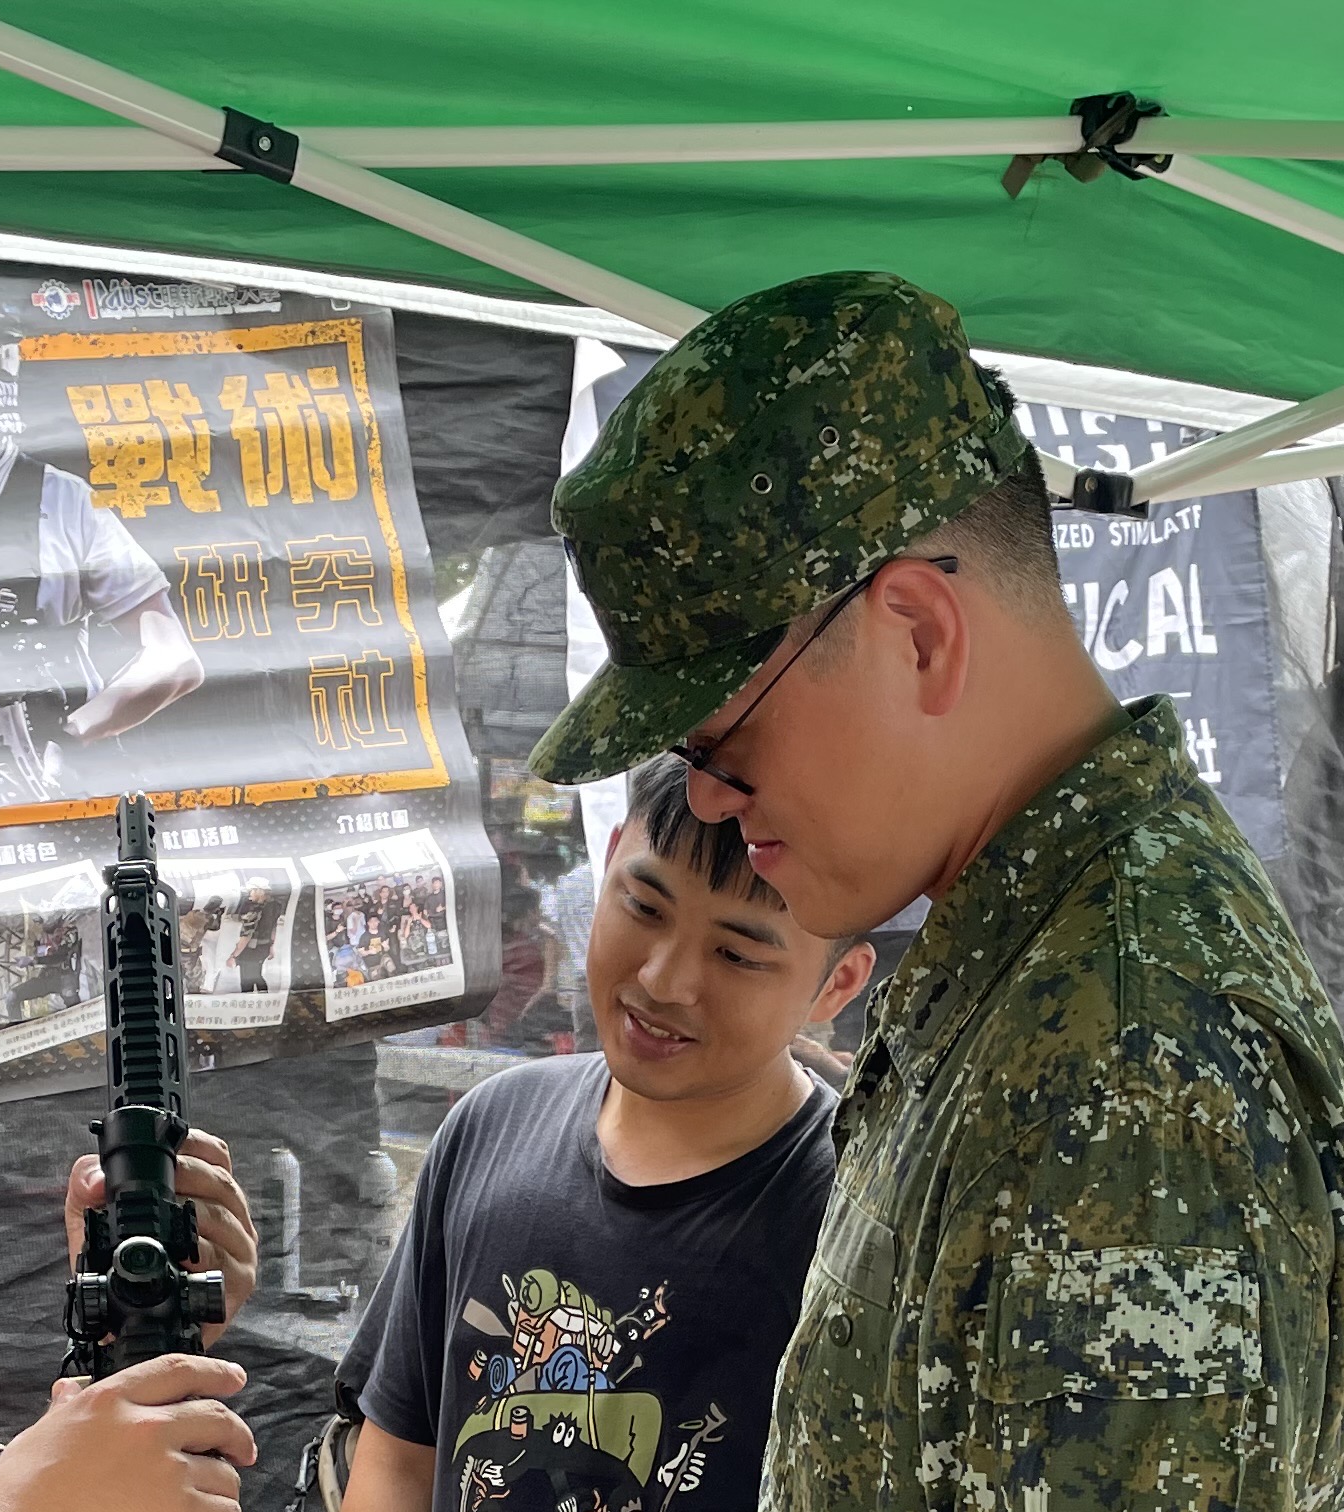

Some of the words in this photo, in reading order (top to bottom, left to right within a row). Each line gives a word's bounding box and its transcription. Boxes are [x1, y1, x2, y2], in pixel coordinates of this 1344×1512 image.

[66, 366, 358, 518] 戰術
[173, 534, 383, 642] 研究
[308, 649, 408, 750] 社
